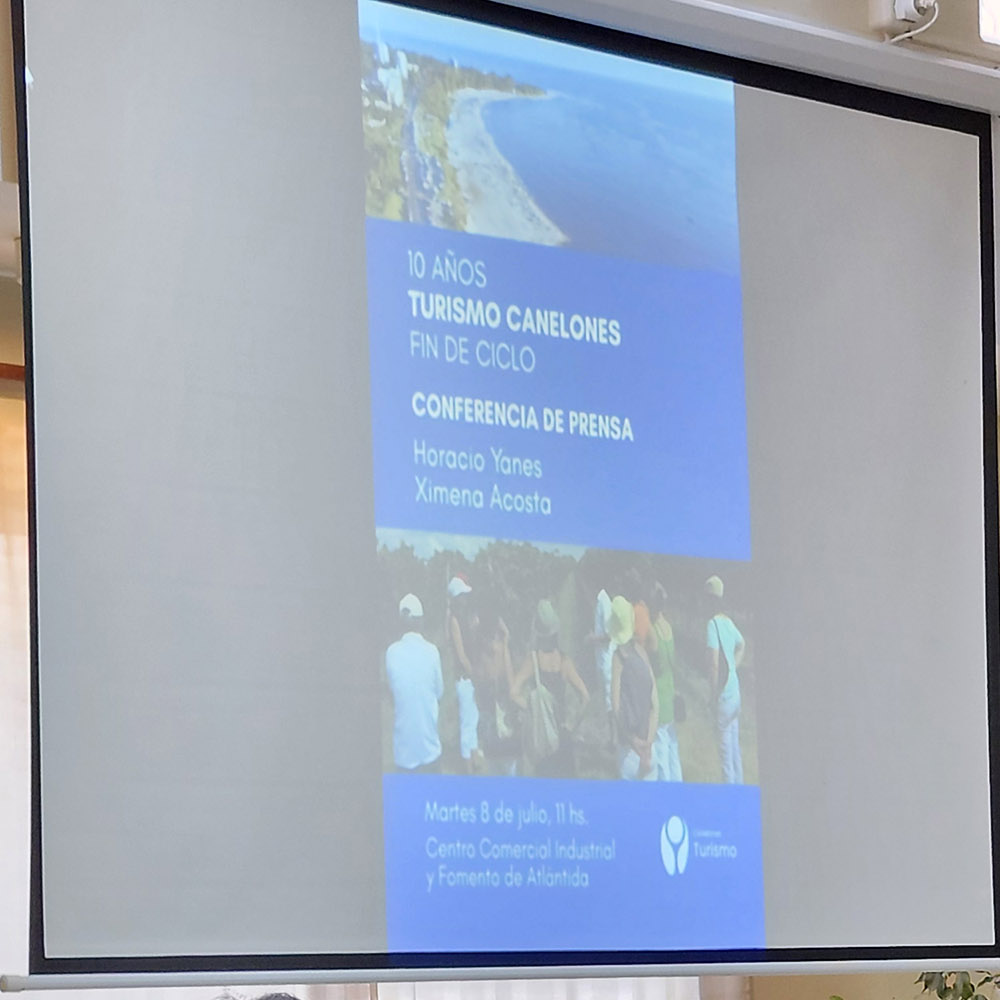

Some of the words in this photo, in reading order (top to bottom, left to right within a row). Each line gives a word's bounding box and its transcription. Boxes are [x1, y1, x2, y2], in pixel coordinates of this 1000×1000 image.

[408, 250, 425, 279] 10
[432, 249, 487, 288] AÑOS
[408, 290, 501, 328] TURISMO
[506, 306, 621, 346] CANELONES
[410, 331, 438, 360] FIN
[445, 335, 469, 364] DE
[476, 339, 535, 373] CICLO
[412, 392, 538, 431] CONFERENCIA
[544, 408, 563, 433] DE
[569, 411, 634, 441] PRENSA
[414, 440, 485, 472] Horacio
[490, 447, 542, 478] Yanes
[415, 476, 483, 509] Ximena
[490, 484, 551, 515] Acosta
[424, 800, 476, 823] Martes
[480, 801, 490, 823] 8
[494, 801, 513, 823] de
[426, 836, 475, 859] Centro
[479, 837, 551, 859] Comercial
[555, 838, 616, 860] Industrial
[694, 842, 737, 858] Turismo
[426, 872, 434, 893] y
[438, 865, 499, 887] Fomento
[504, 865, 522, 887] de
